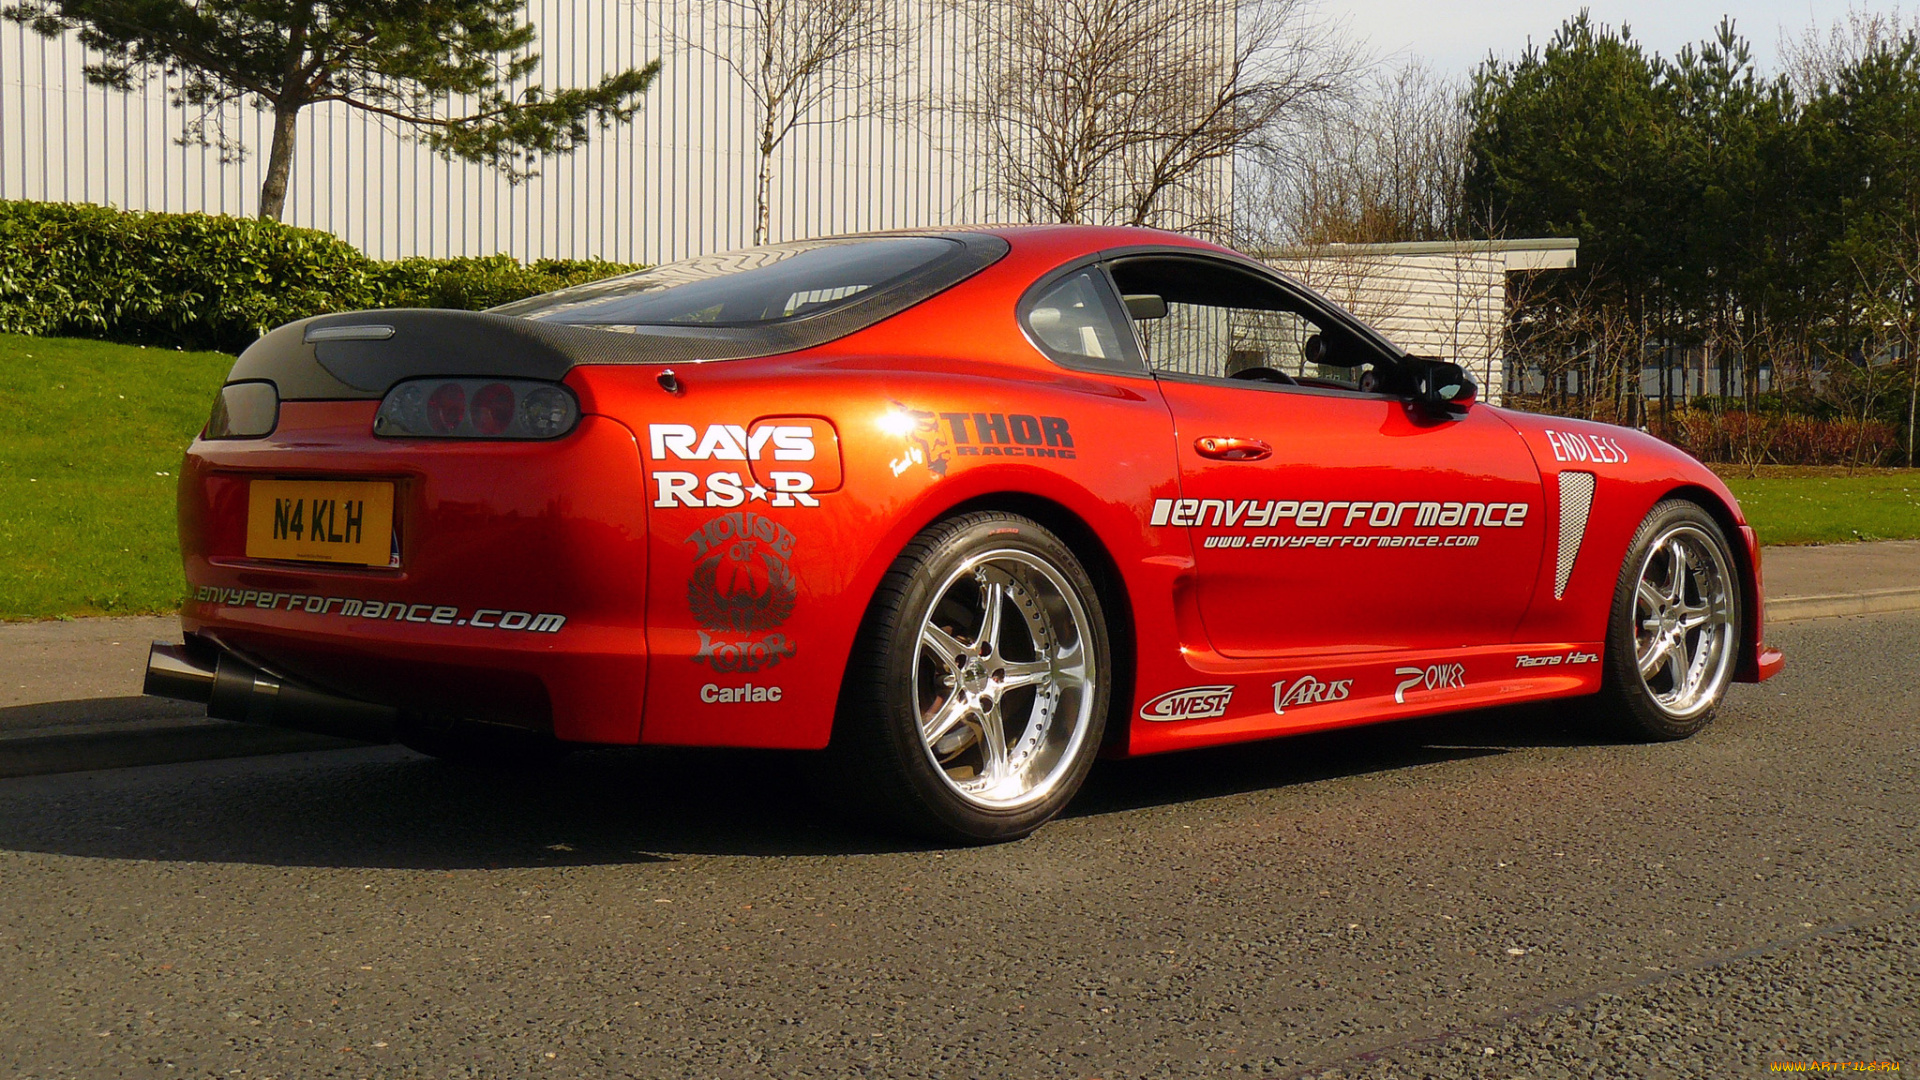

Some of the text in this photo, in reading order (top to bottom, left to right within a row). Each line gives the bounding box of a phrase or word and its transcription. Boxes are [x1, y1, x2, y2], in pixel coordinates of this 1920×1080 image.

[649, 424, 815, 461] RAYS
[939, 412, 1074, 448] THOR
[1545, 429, 1628, 463] ENDLESS
[956, 446, 1077, 459] RACING
[273, 498, 363, 544] N4 KLH
[684, 512, 797, 562] HOUSE
[729, 540, 757, 562] OF
[1203, 535, 1480, 548] www.envyperformance.com
[690, 629, 797, 673] KOLOR
[1516, 651, 1599, 668] Racing Hart
[700, 683, 782, 703] Carlac
